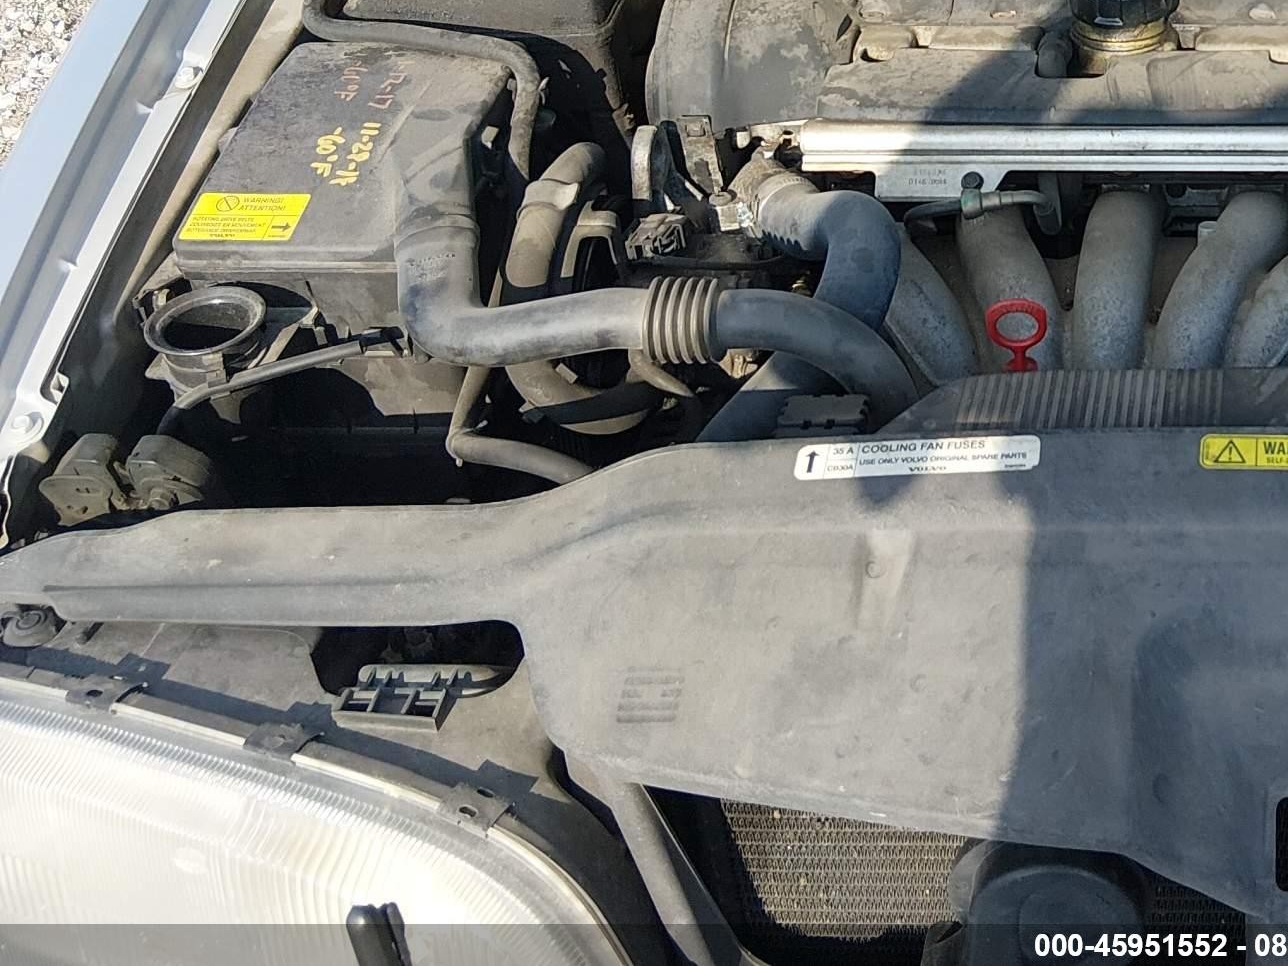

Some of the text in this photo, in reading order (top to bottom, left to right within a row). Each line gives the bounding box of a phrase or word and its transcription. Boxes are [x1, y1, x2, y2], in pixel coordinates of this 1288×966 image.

[861, 440, 985, 454] COOLING FAN FUSES
[878, 456, 900, 465] ONLY
[901, 455, 928, 464] VOLVO
